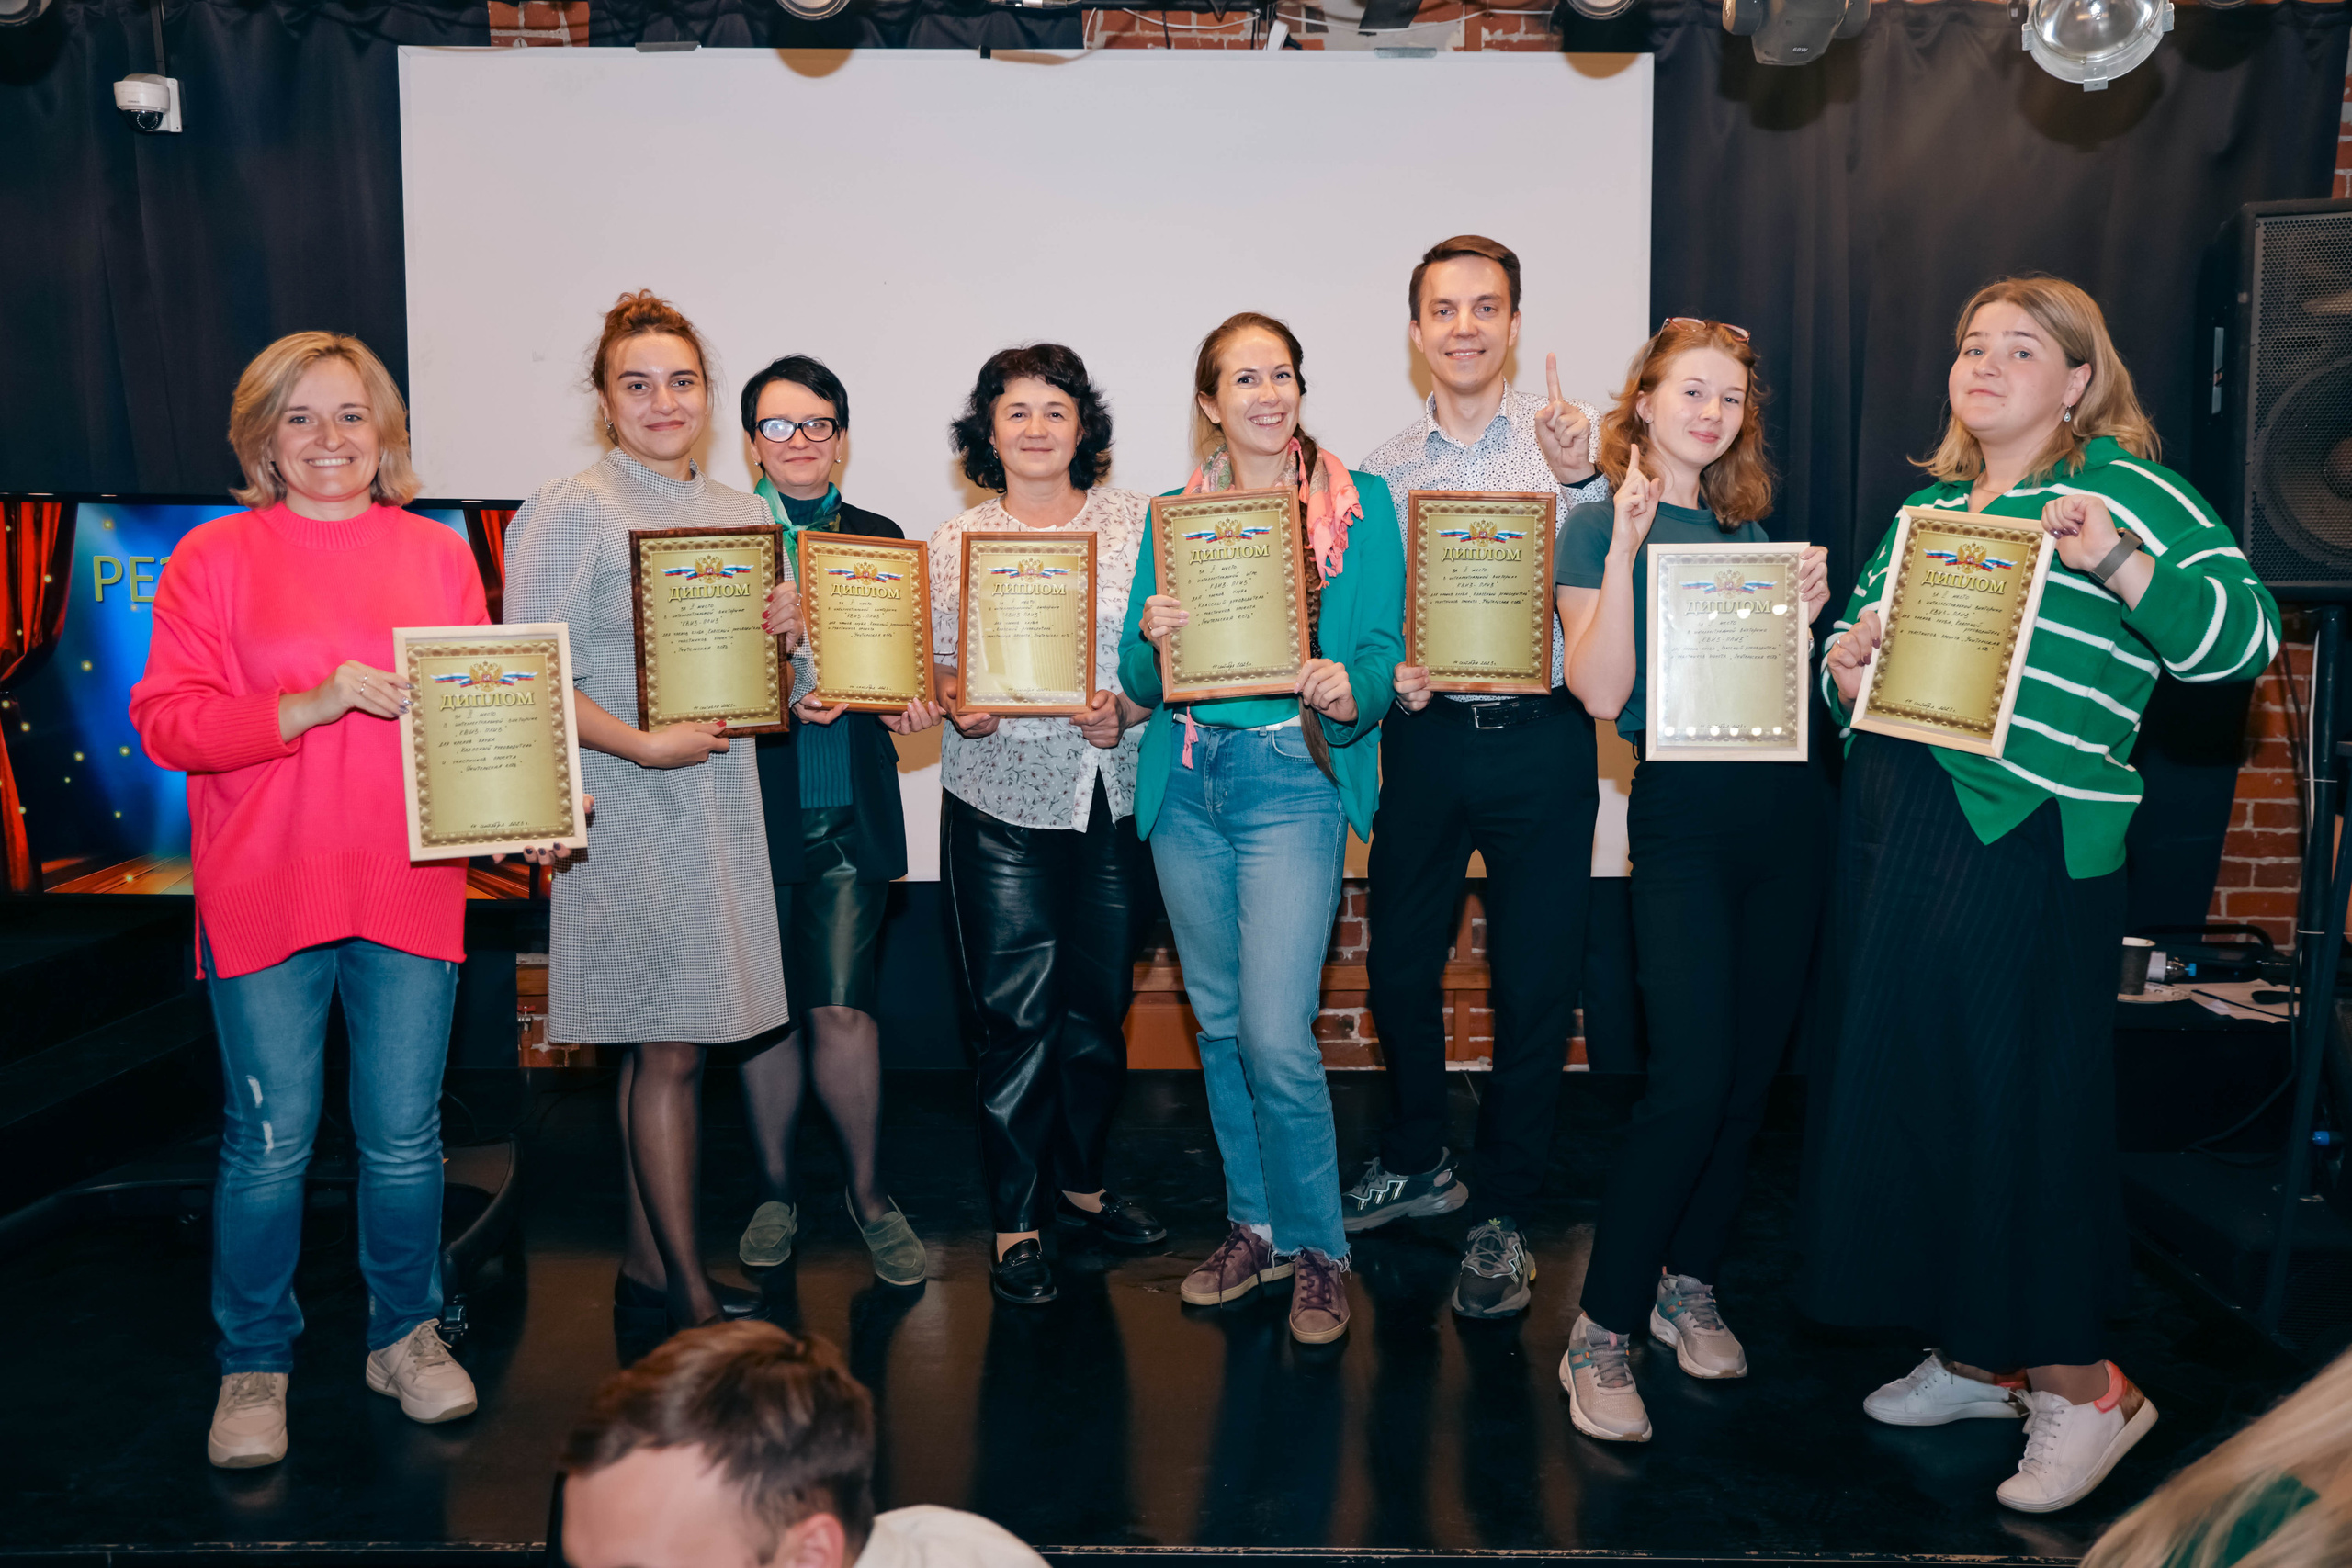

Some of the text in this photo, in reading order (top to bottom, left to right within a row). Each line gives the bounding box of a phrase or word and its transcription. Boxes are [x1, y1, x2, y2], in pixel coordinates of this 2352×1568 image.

[1189, 544, 1270, 565] ДИПЛОМ
[1442, 547, 1521, 562] ДИПЛОМ
[93, 556, 171, 603] РЕ
[992, 583, 1066, 596] ДИПЛОМ
[1921, 570, 2007, 595] ДИПЛОМ
[668, 583, 751, 603] ДИПЛОМ
[831, 583, 901, 600] ДИПЛОМ
[1685, 600, 1772, 615] ДИПЛОМ
[439, 691, 535, 711] ДИПЛОМ
